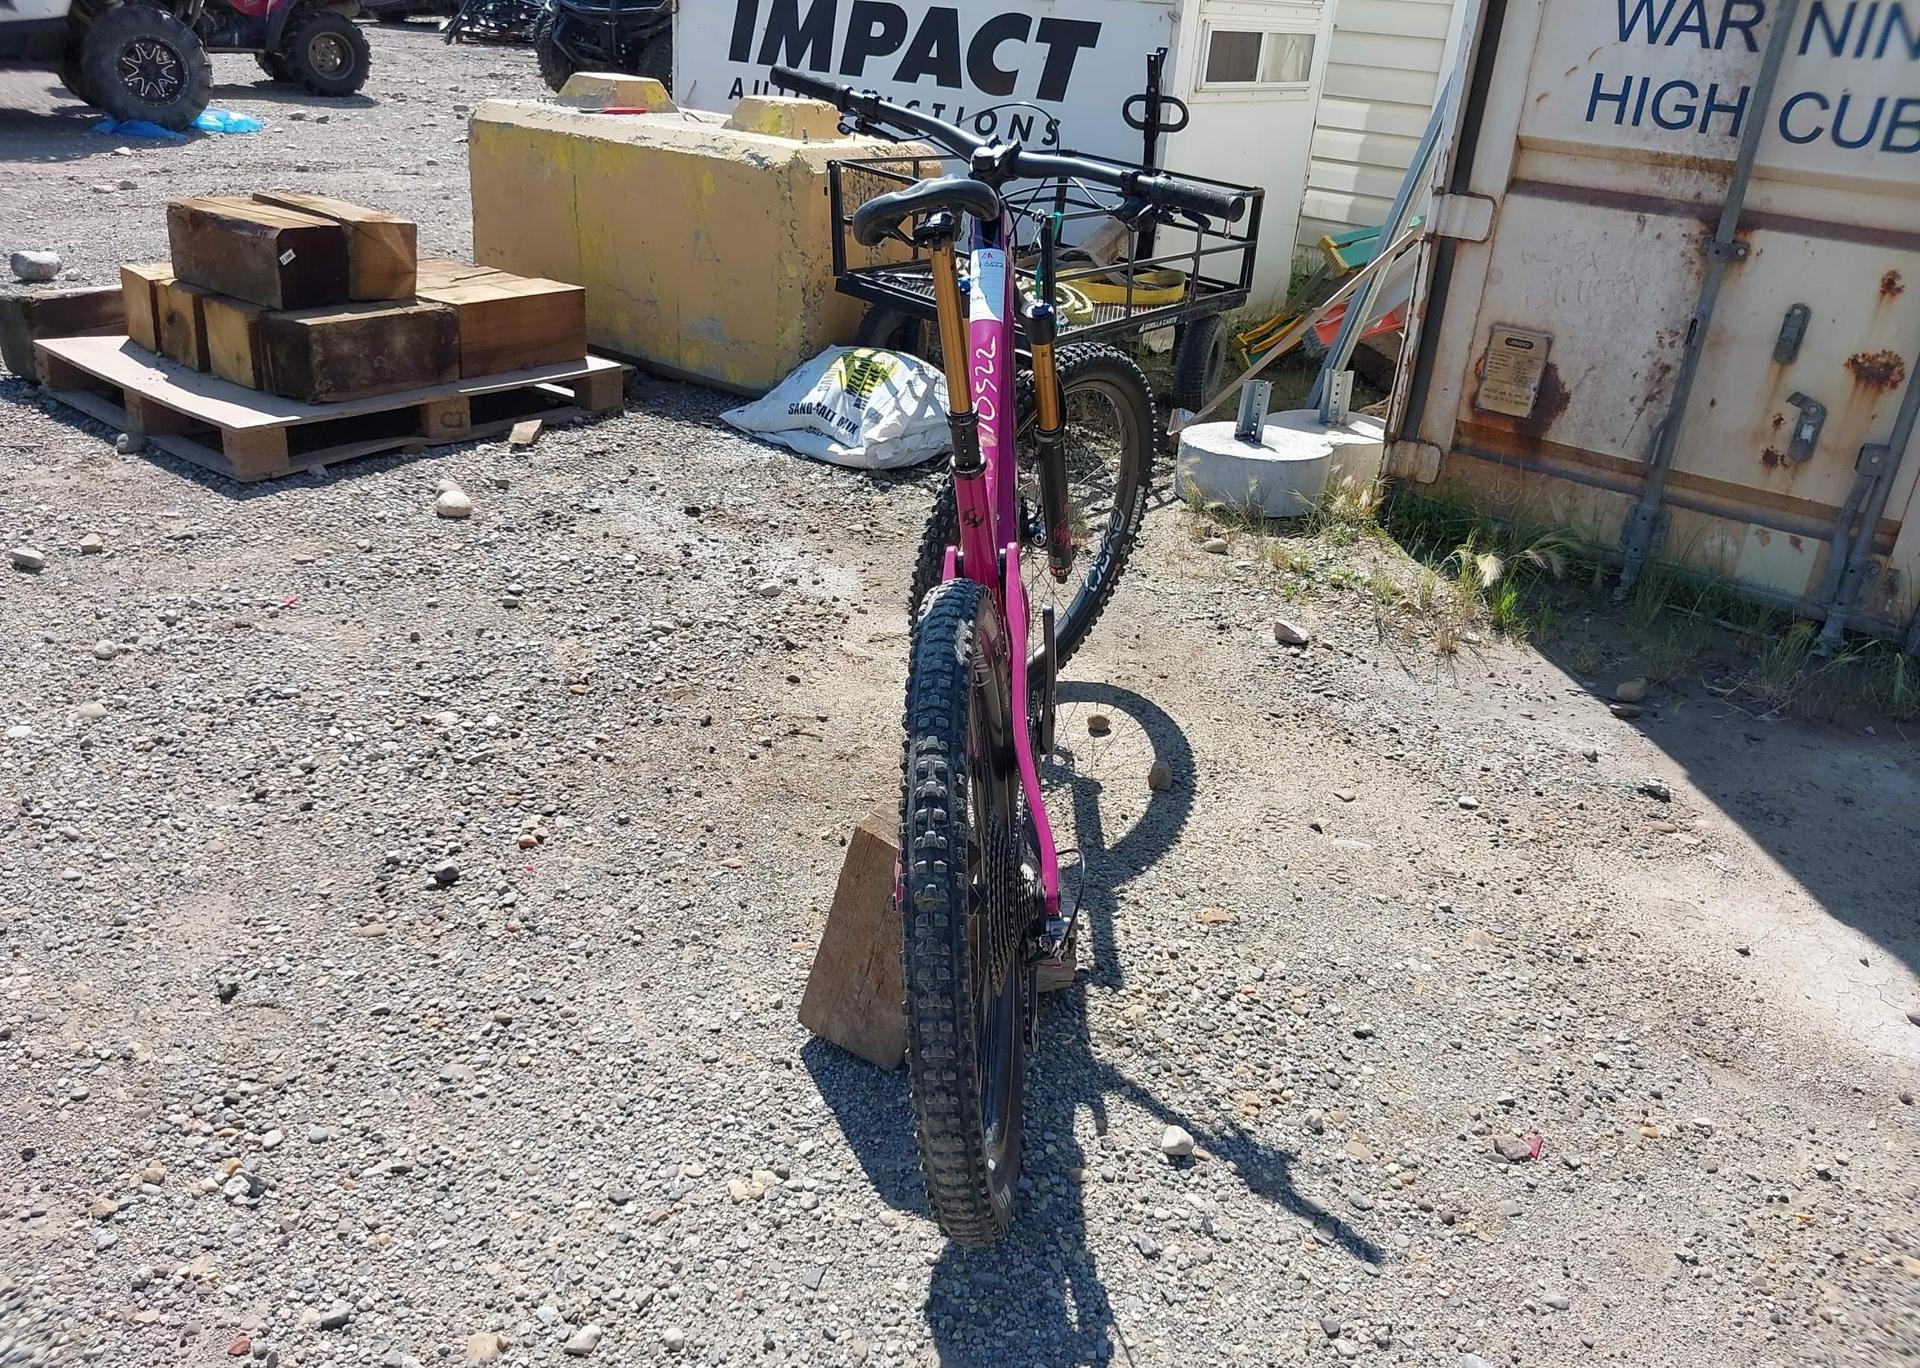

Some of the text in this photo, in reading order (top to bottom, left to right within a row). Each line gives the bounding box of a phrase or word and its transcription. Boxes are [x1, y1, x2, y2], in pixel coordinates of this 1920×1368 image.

[728, 0, 1102, 102] IMPACT
[1585, 73, 1920, 154] HIGH CUB
[836, 415, 859, 435] MIX
